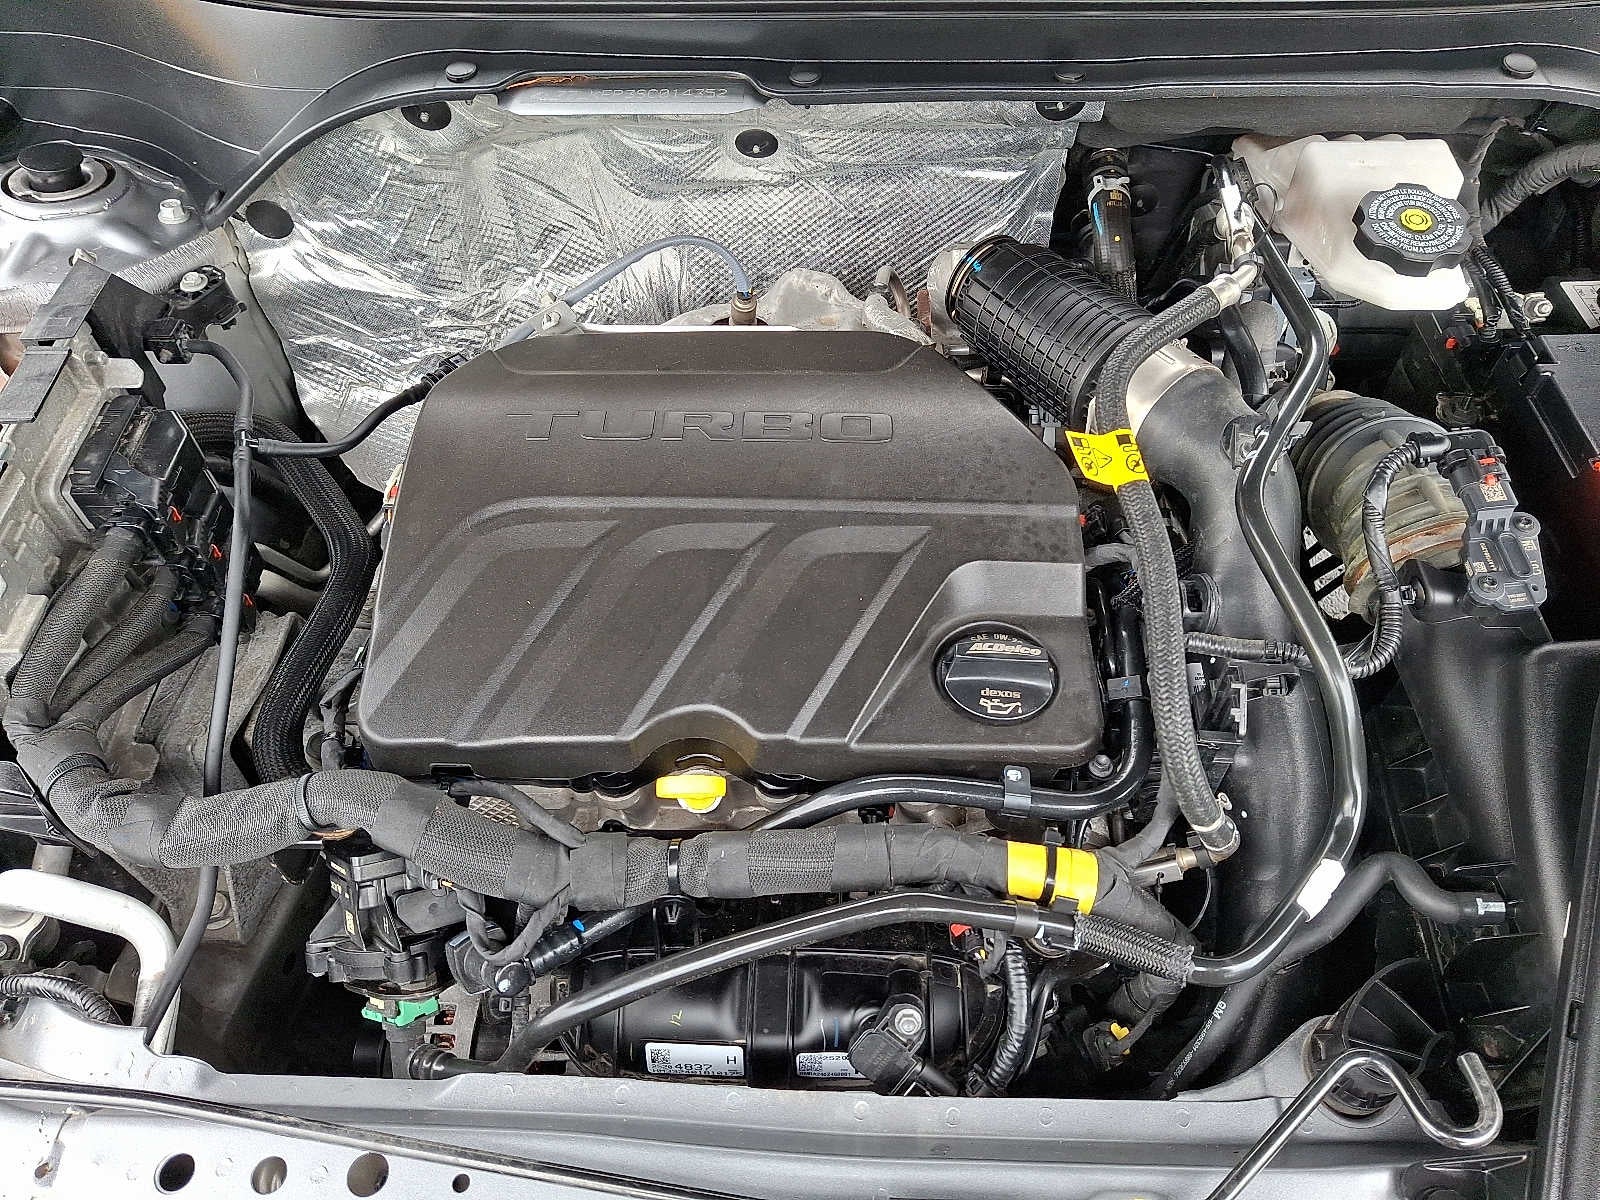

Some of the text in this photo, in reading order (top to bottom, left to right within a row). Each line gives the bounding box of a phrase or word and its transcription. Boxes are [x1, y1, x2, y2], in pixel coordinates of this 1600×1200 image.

[506, 410, 893, 443] TURBO
[967, 642, 1042, 656] ACDelco
[980, 687, 1021, 699] dexos
[725, 1055, 737, 1065] H
